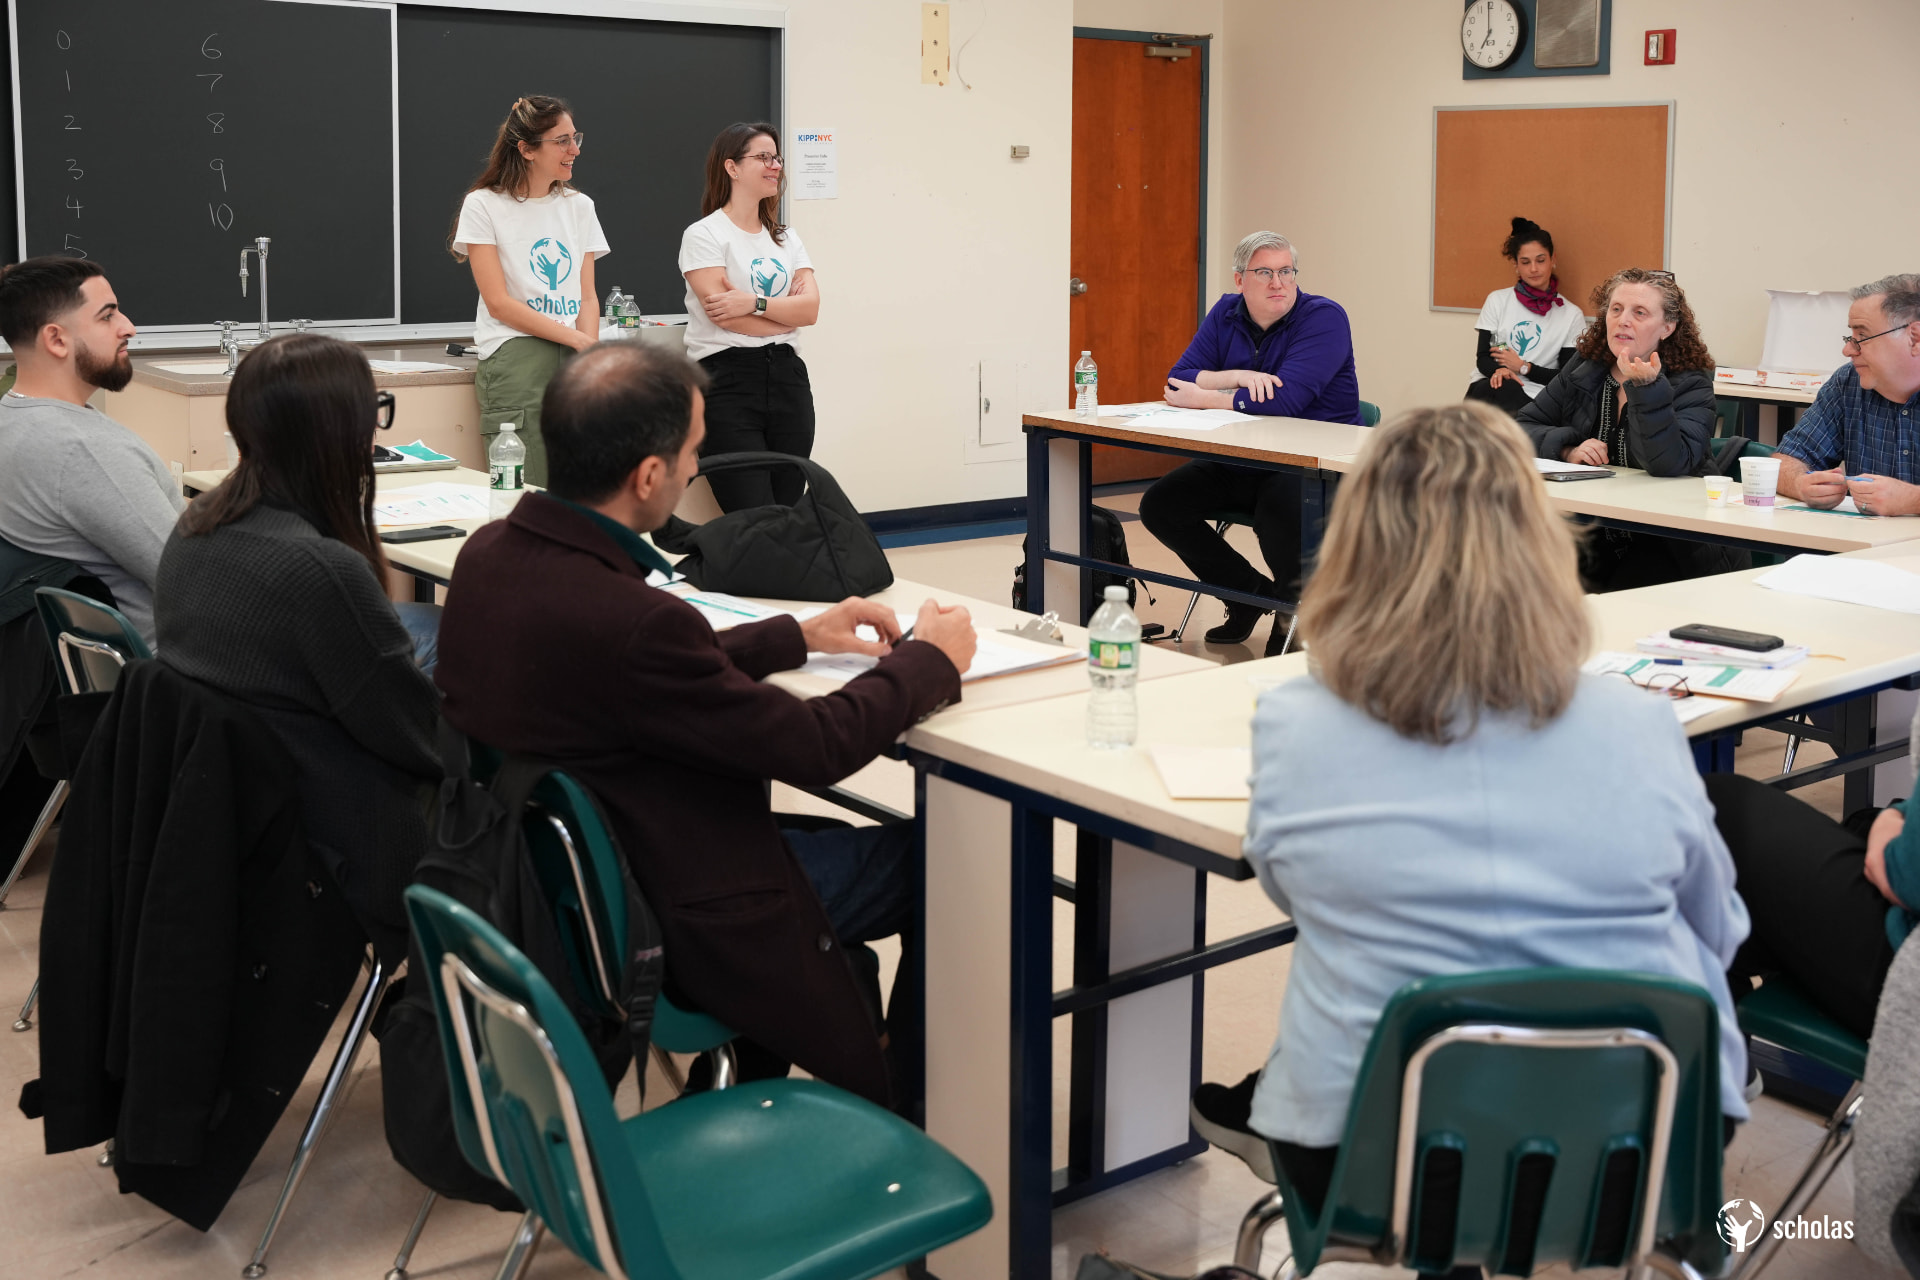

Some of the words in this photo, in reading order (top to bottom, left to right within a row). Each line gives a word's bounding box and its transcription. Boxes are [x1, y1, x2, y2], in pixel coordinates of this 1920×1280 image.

[1468, 16, 1476, 24] 10
[1506, 12, 1512, 21] 2
[56, 29, 71, 50] 0
[1466, 29, 1472, 37] 9
[1510, 26, 1515, 35] 3
[201, 32, 222, 60] 6
[1469, 42, 1475, 51] 8
[1477, 51, 1482, 60] 7
[1498, 50, 1504, 59] 5
[1487, 55, 1493, 63] 6
[65, 68, 71, 93] 1
[195, 73, 223, 93] 7
[63, 115, 82, 130] 2
[206, 112, 225, 134] 8
[65, 158, 84, 180] 3
[209, 158, 227, 193] 9
[65, 194, 84, 219] 4
[208, 202, 234, 231] 10
[64, 233, 88, 260] 5
